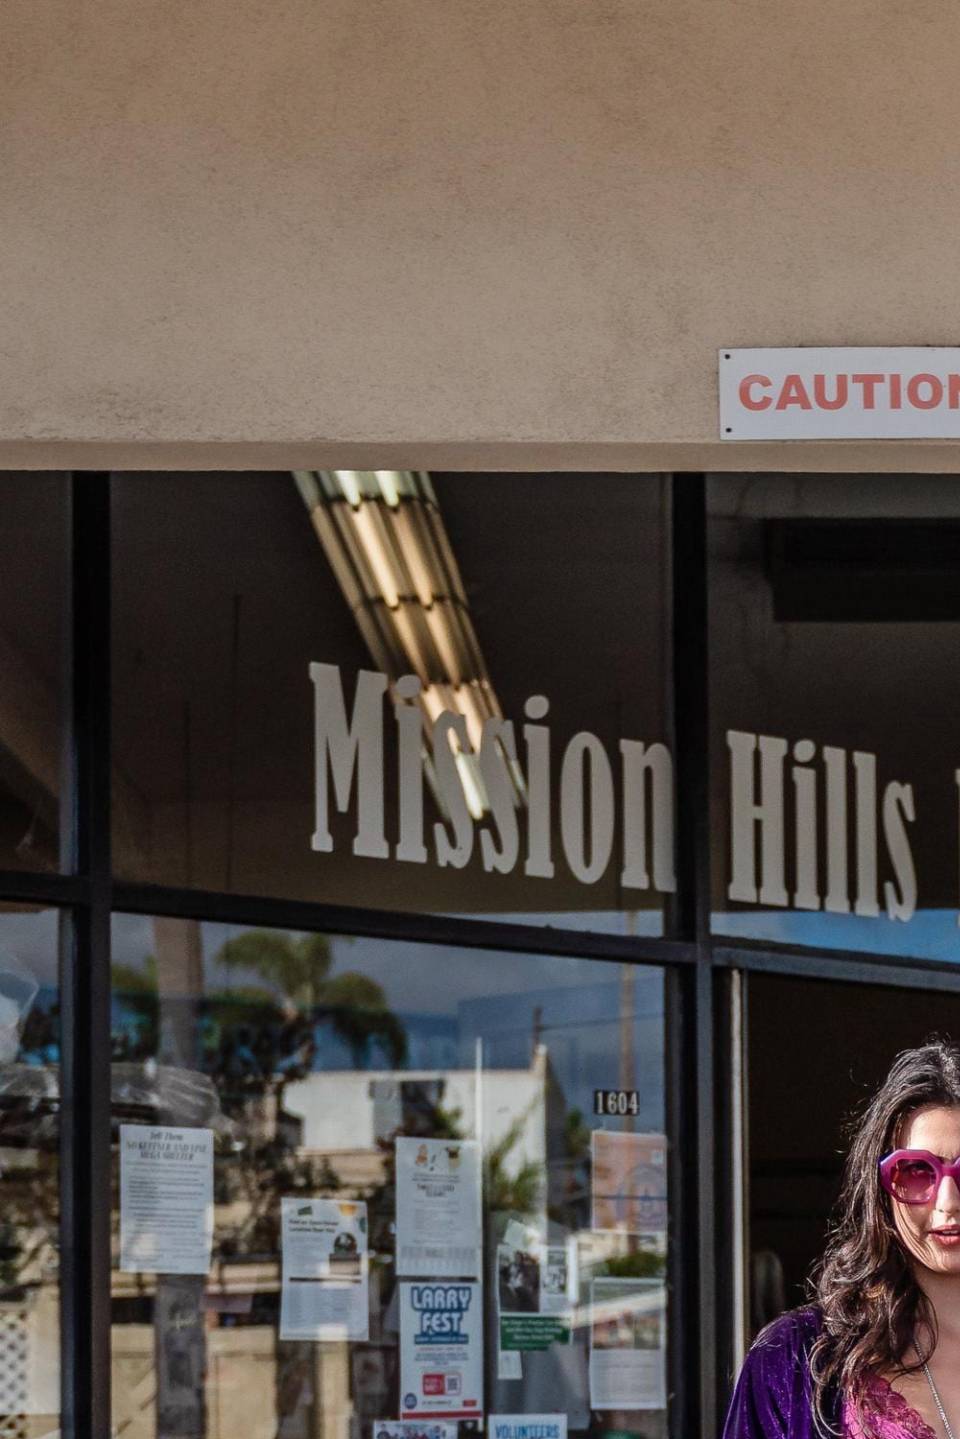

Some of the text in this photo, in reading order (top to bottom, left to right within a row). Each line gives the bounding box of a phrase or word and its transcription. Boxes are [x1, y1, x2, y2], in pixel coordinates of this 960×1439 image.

[308, 661, 677, 893] Mission
[727, 730, 918, 924] Hills
[596, 1091, 640, 1115] 1604
[412, 1287, 472, 1311] LARRY
[421, 1311, 463, 1333] FEST
[495, 1424, 560, 1439] VOLUNTEERS
